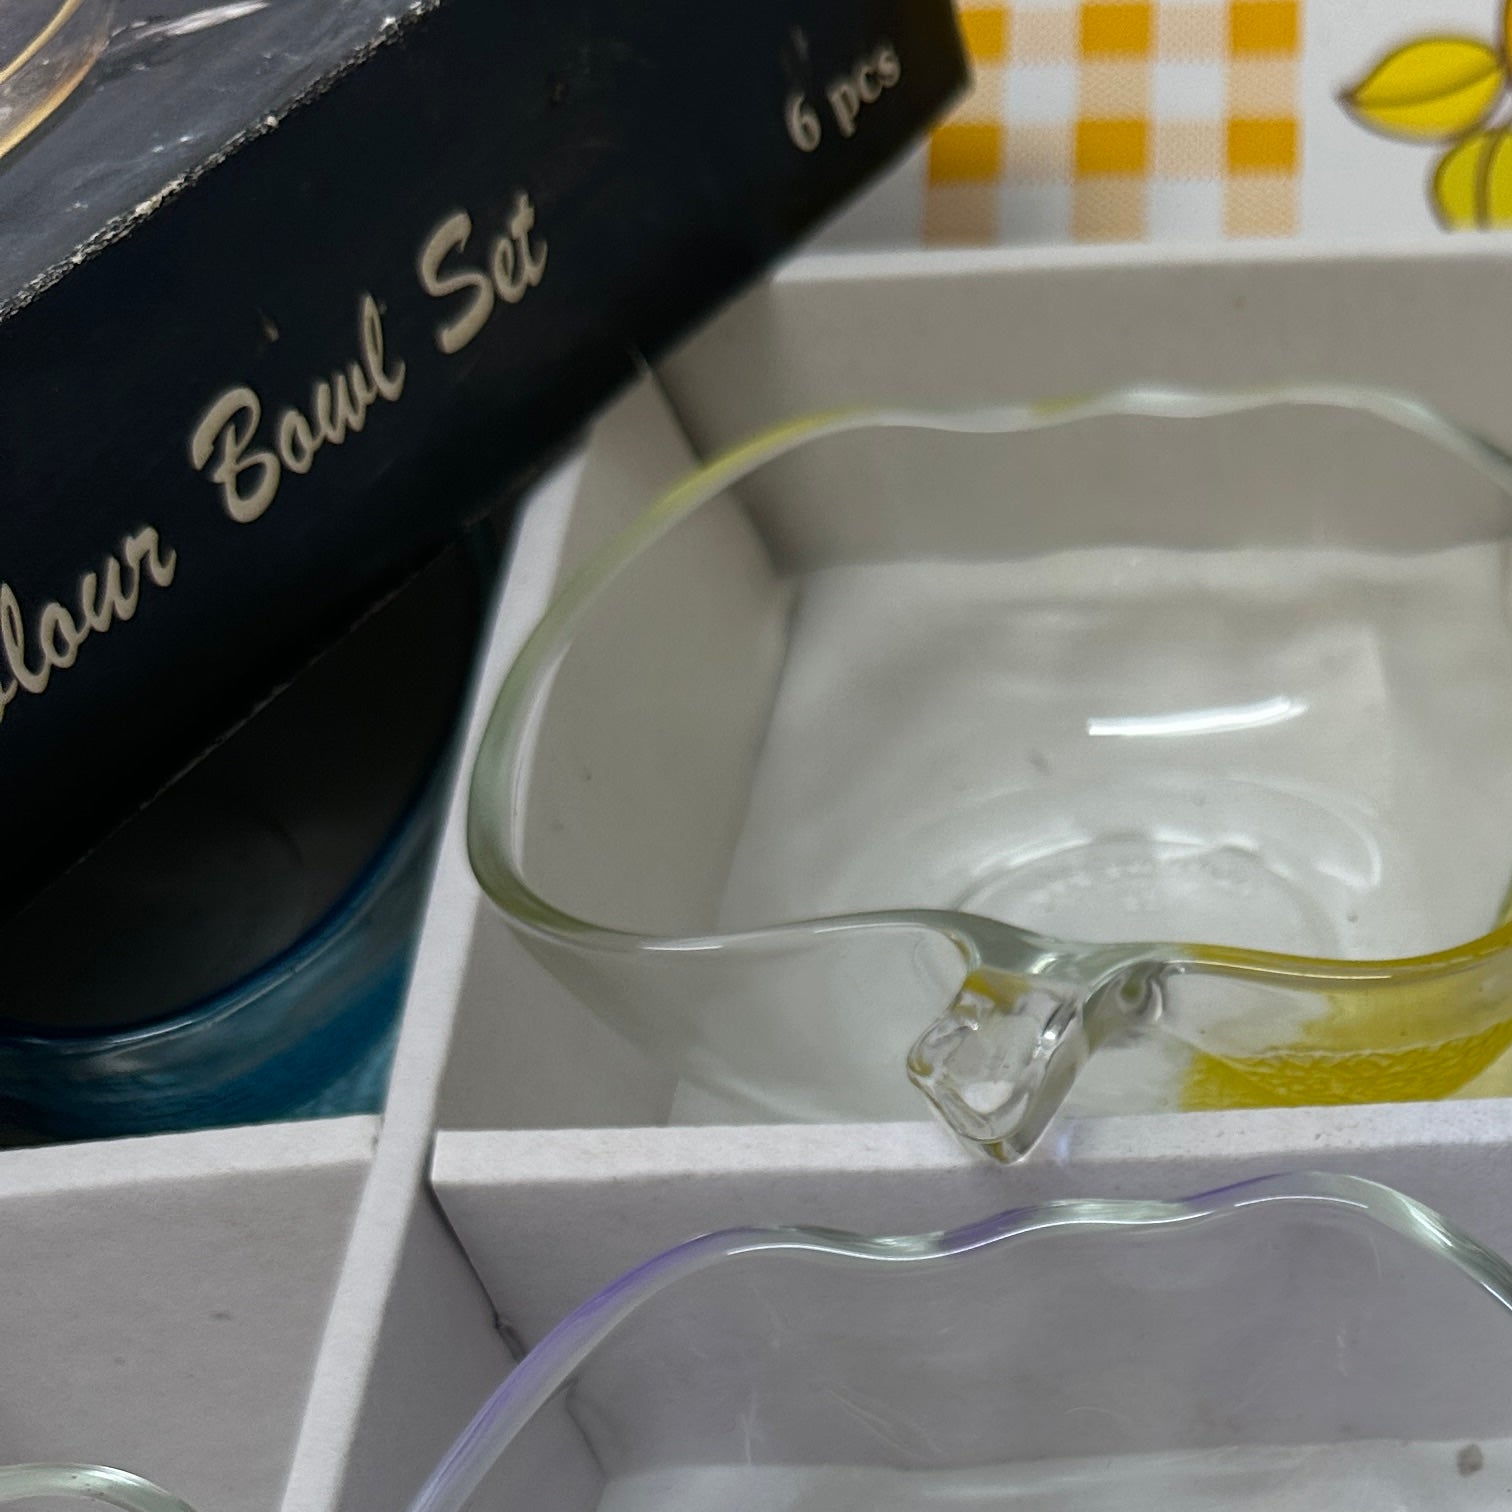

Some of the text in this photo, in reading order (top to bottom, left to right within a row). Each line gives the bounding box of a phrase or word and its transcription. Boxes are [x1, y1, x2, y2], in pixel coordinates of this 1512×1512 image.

[784, 47, 901, 152] 6 pcs
[0, 193, 548, 720] lour Bowl Set
